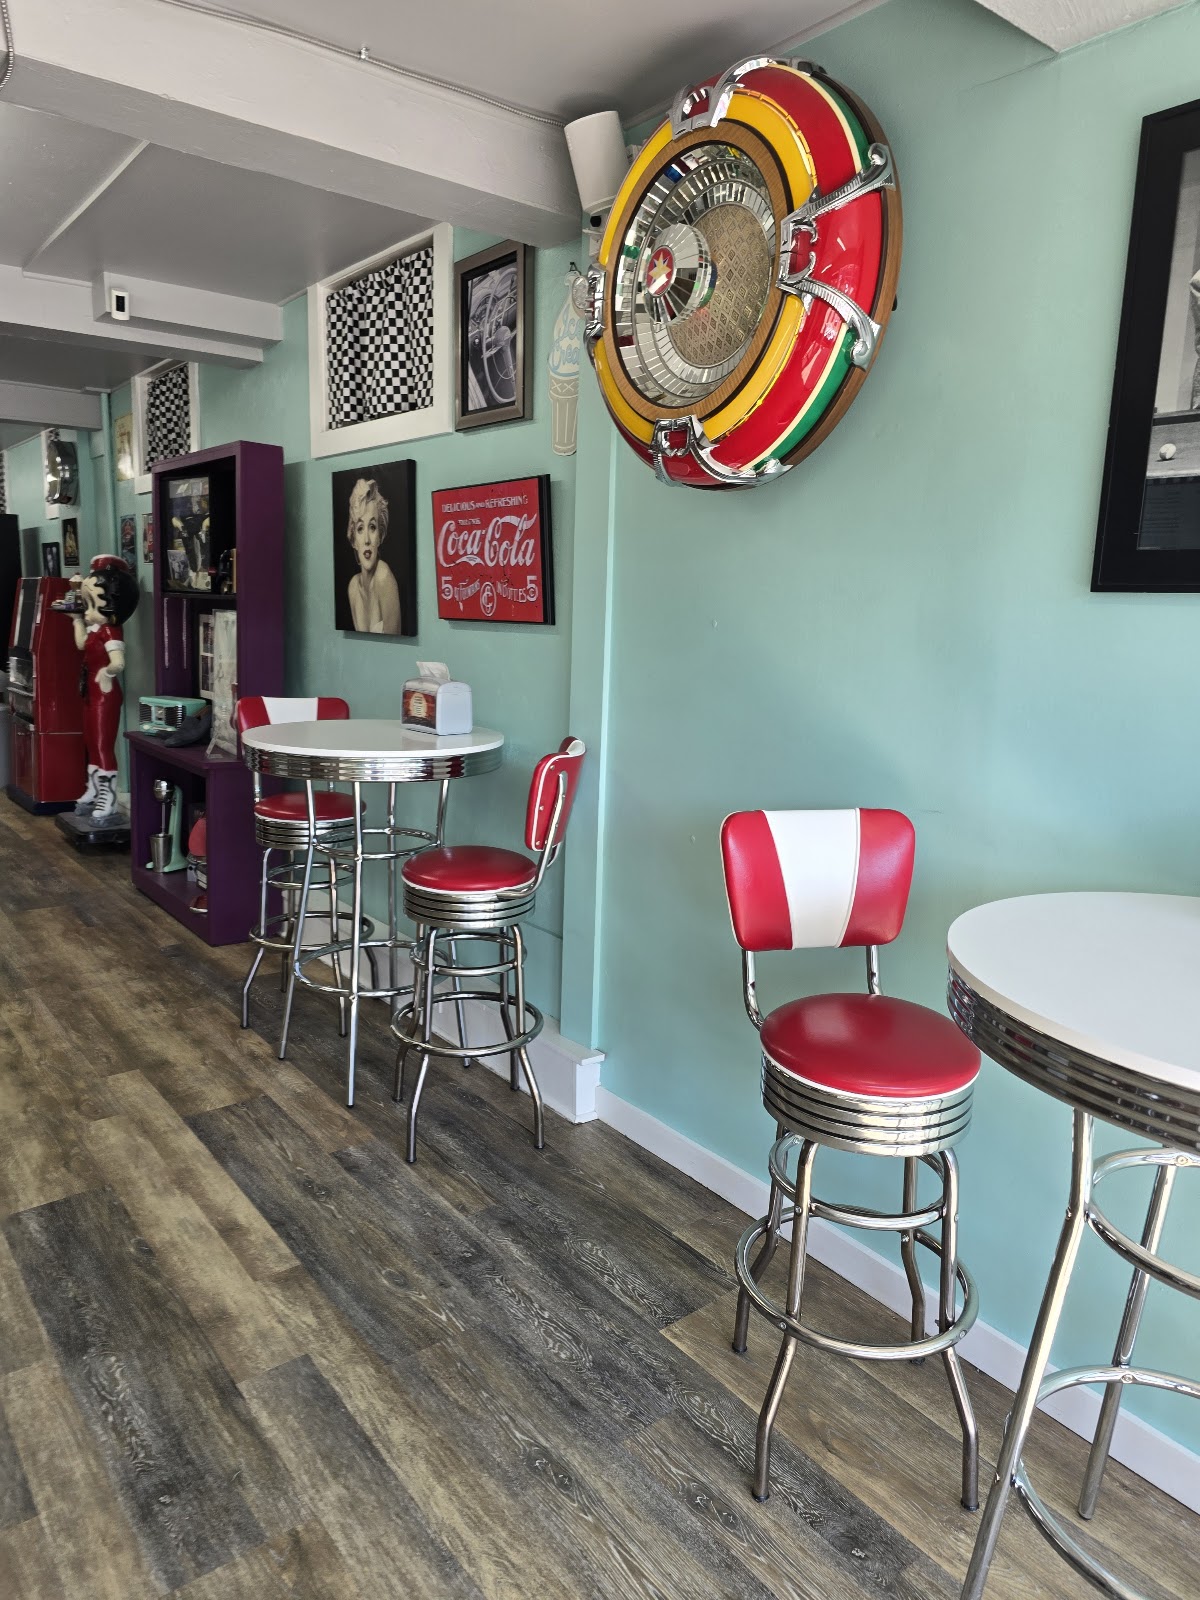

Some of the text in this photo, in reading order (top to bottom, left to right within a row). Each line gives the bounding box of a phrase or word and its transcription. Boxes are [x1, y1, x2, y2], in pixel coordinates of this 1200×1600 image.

[442, 501, 475, 512] DELICIOUS
[485, 495, 528, 508] REFRESHING
[438, 514, 537, 567] Coca-Cola
